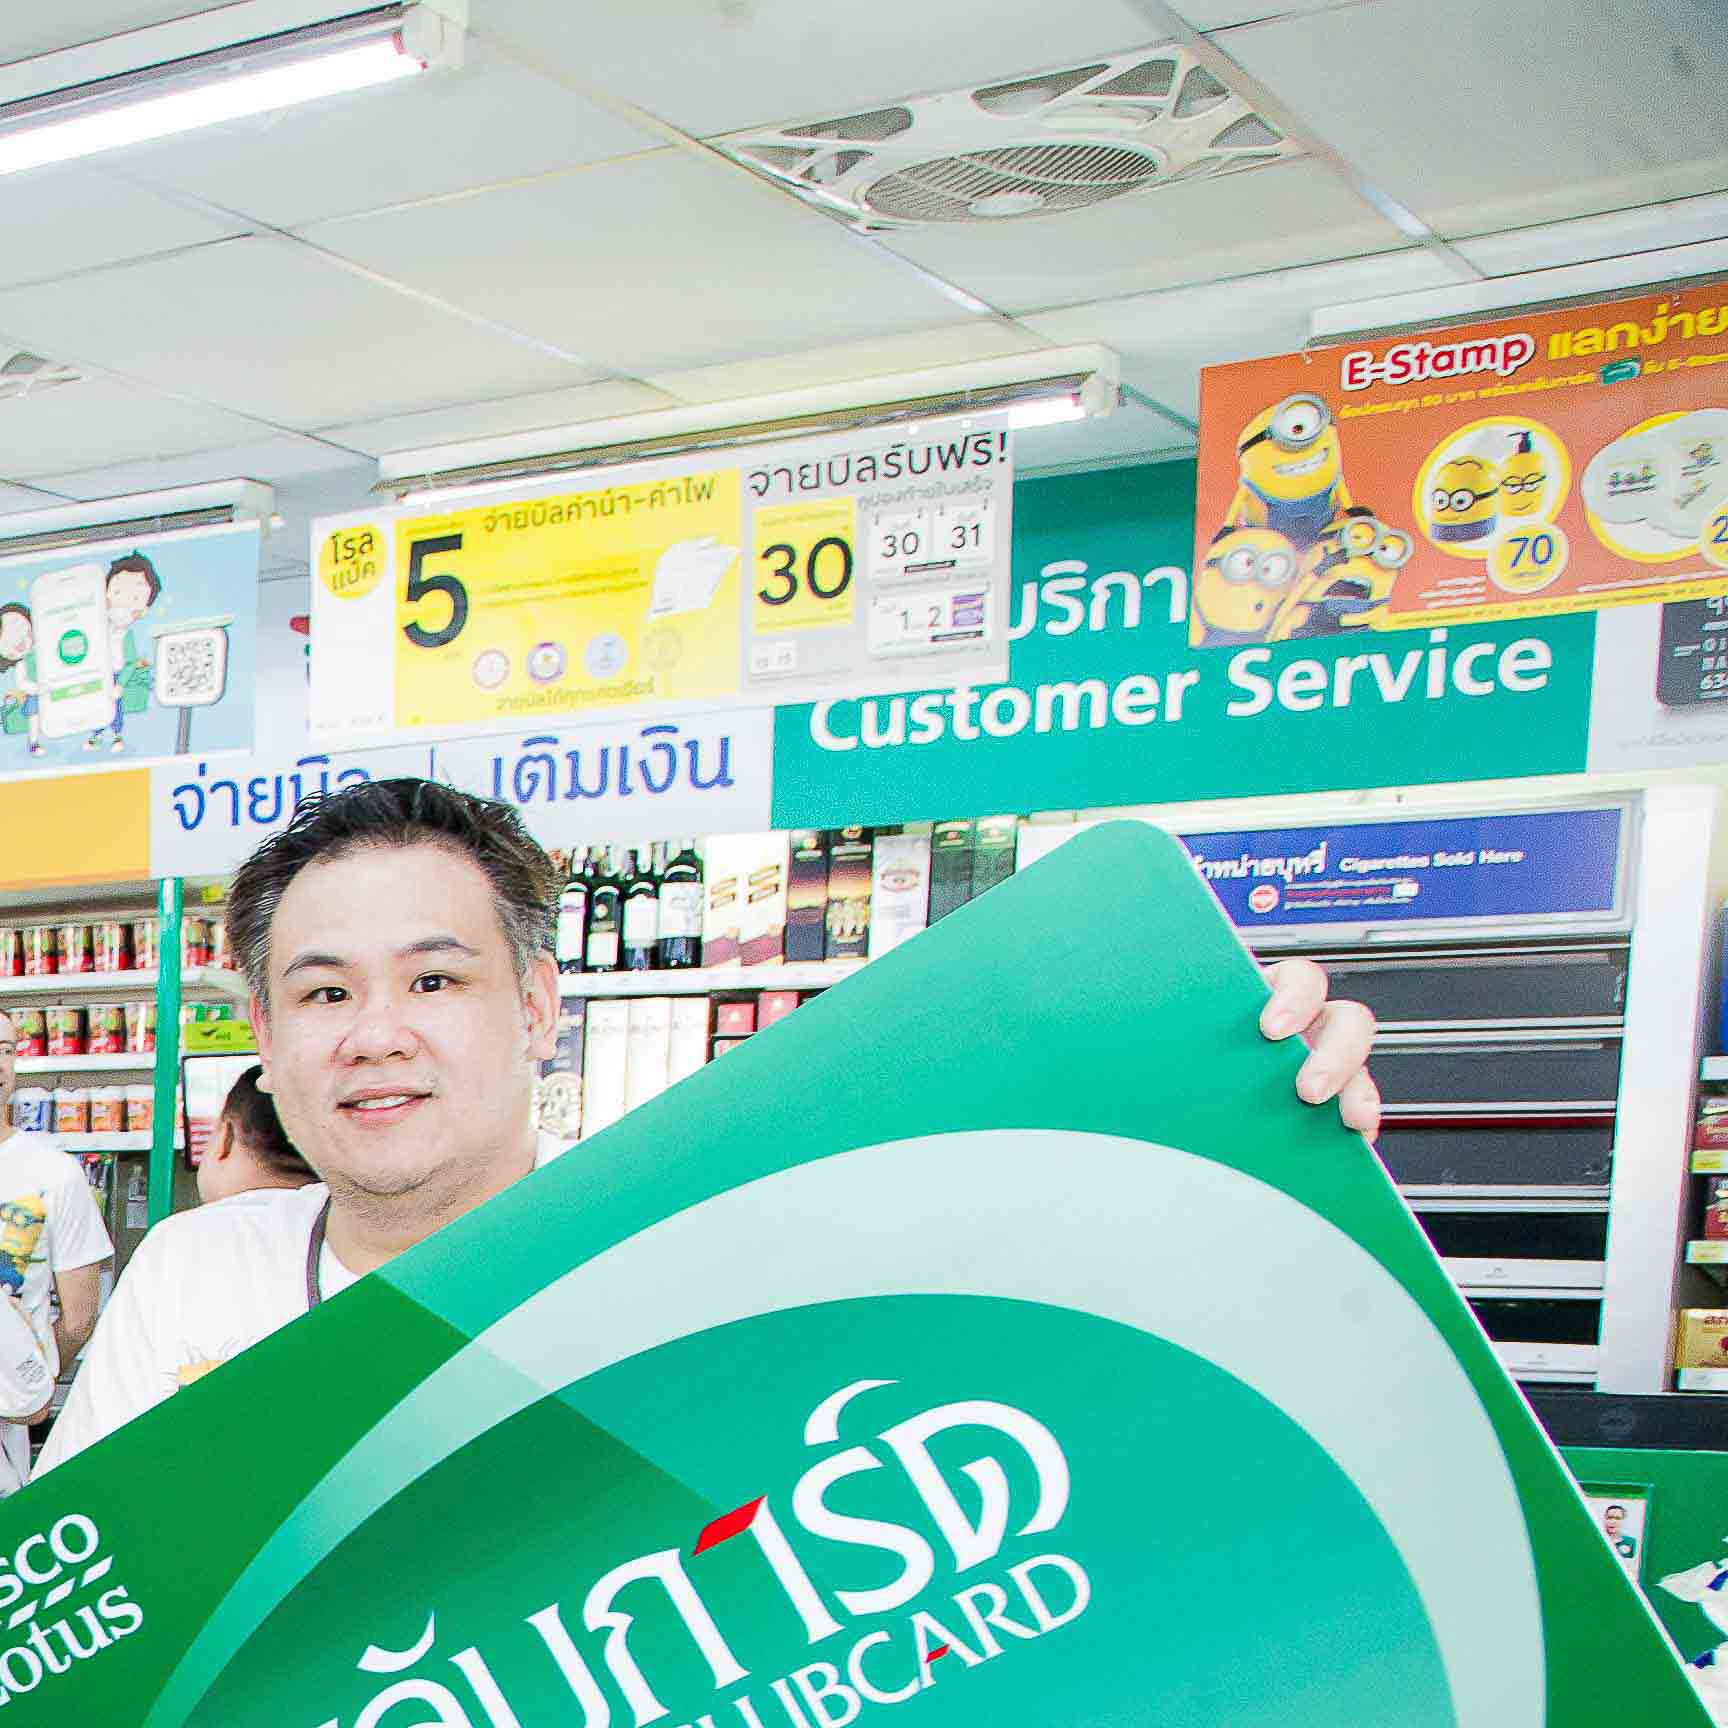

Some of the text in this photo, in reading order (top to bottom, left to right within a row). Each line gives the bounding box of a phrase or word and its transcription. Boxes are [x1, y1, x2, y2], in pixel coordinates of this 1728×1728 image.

[1345, 335, 1531, 388] E-Stamp
[749, 431, 1008, 498] จ่ายบิลรับฟรี!
[333, 531, 375, 566] โรล
[881, 532, 920, 558] 30
[950, 523, 982, 549] 31
[1508, 534, 1553, 568] 70
[403, 533, 469, 648] 5
[757, 537, 854, 606] 30
[808, 628, 1554, 754] Customer Service
[491, 724, 734, 804] เติมเงิน
